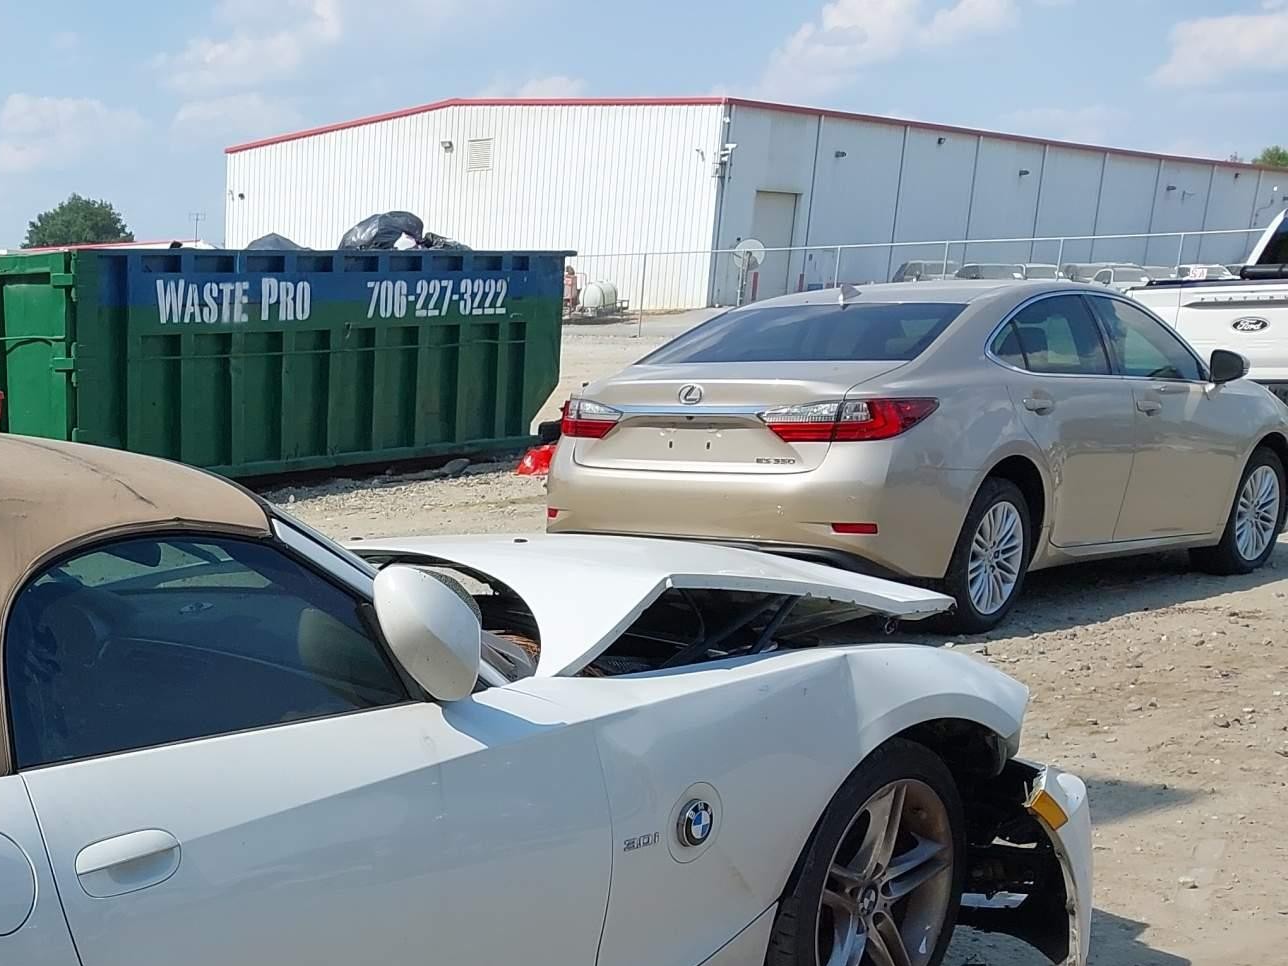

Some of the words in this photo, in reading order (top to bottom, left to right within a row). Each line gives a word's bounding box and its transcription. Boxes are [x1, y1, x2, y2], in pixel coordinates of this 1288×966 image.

[156, 279, 249, 324] WASTE
[261, 277, 311, 321] PRO
[367, 279, 507, 318] 706-227-3222
[1234, 318, 1266, 331] Ford
